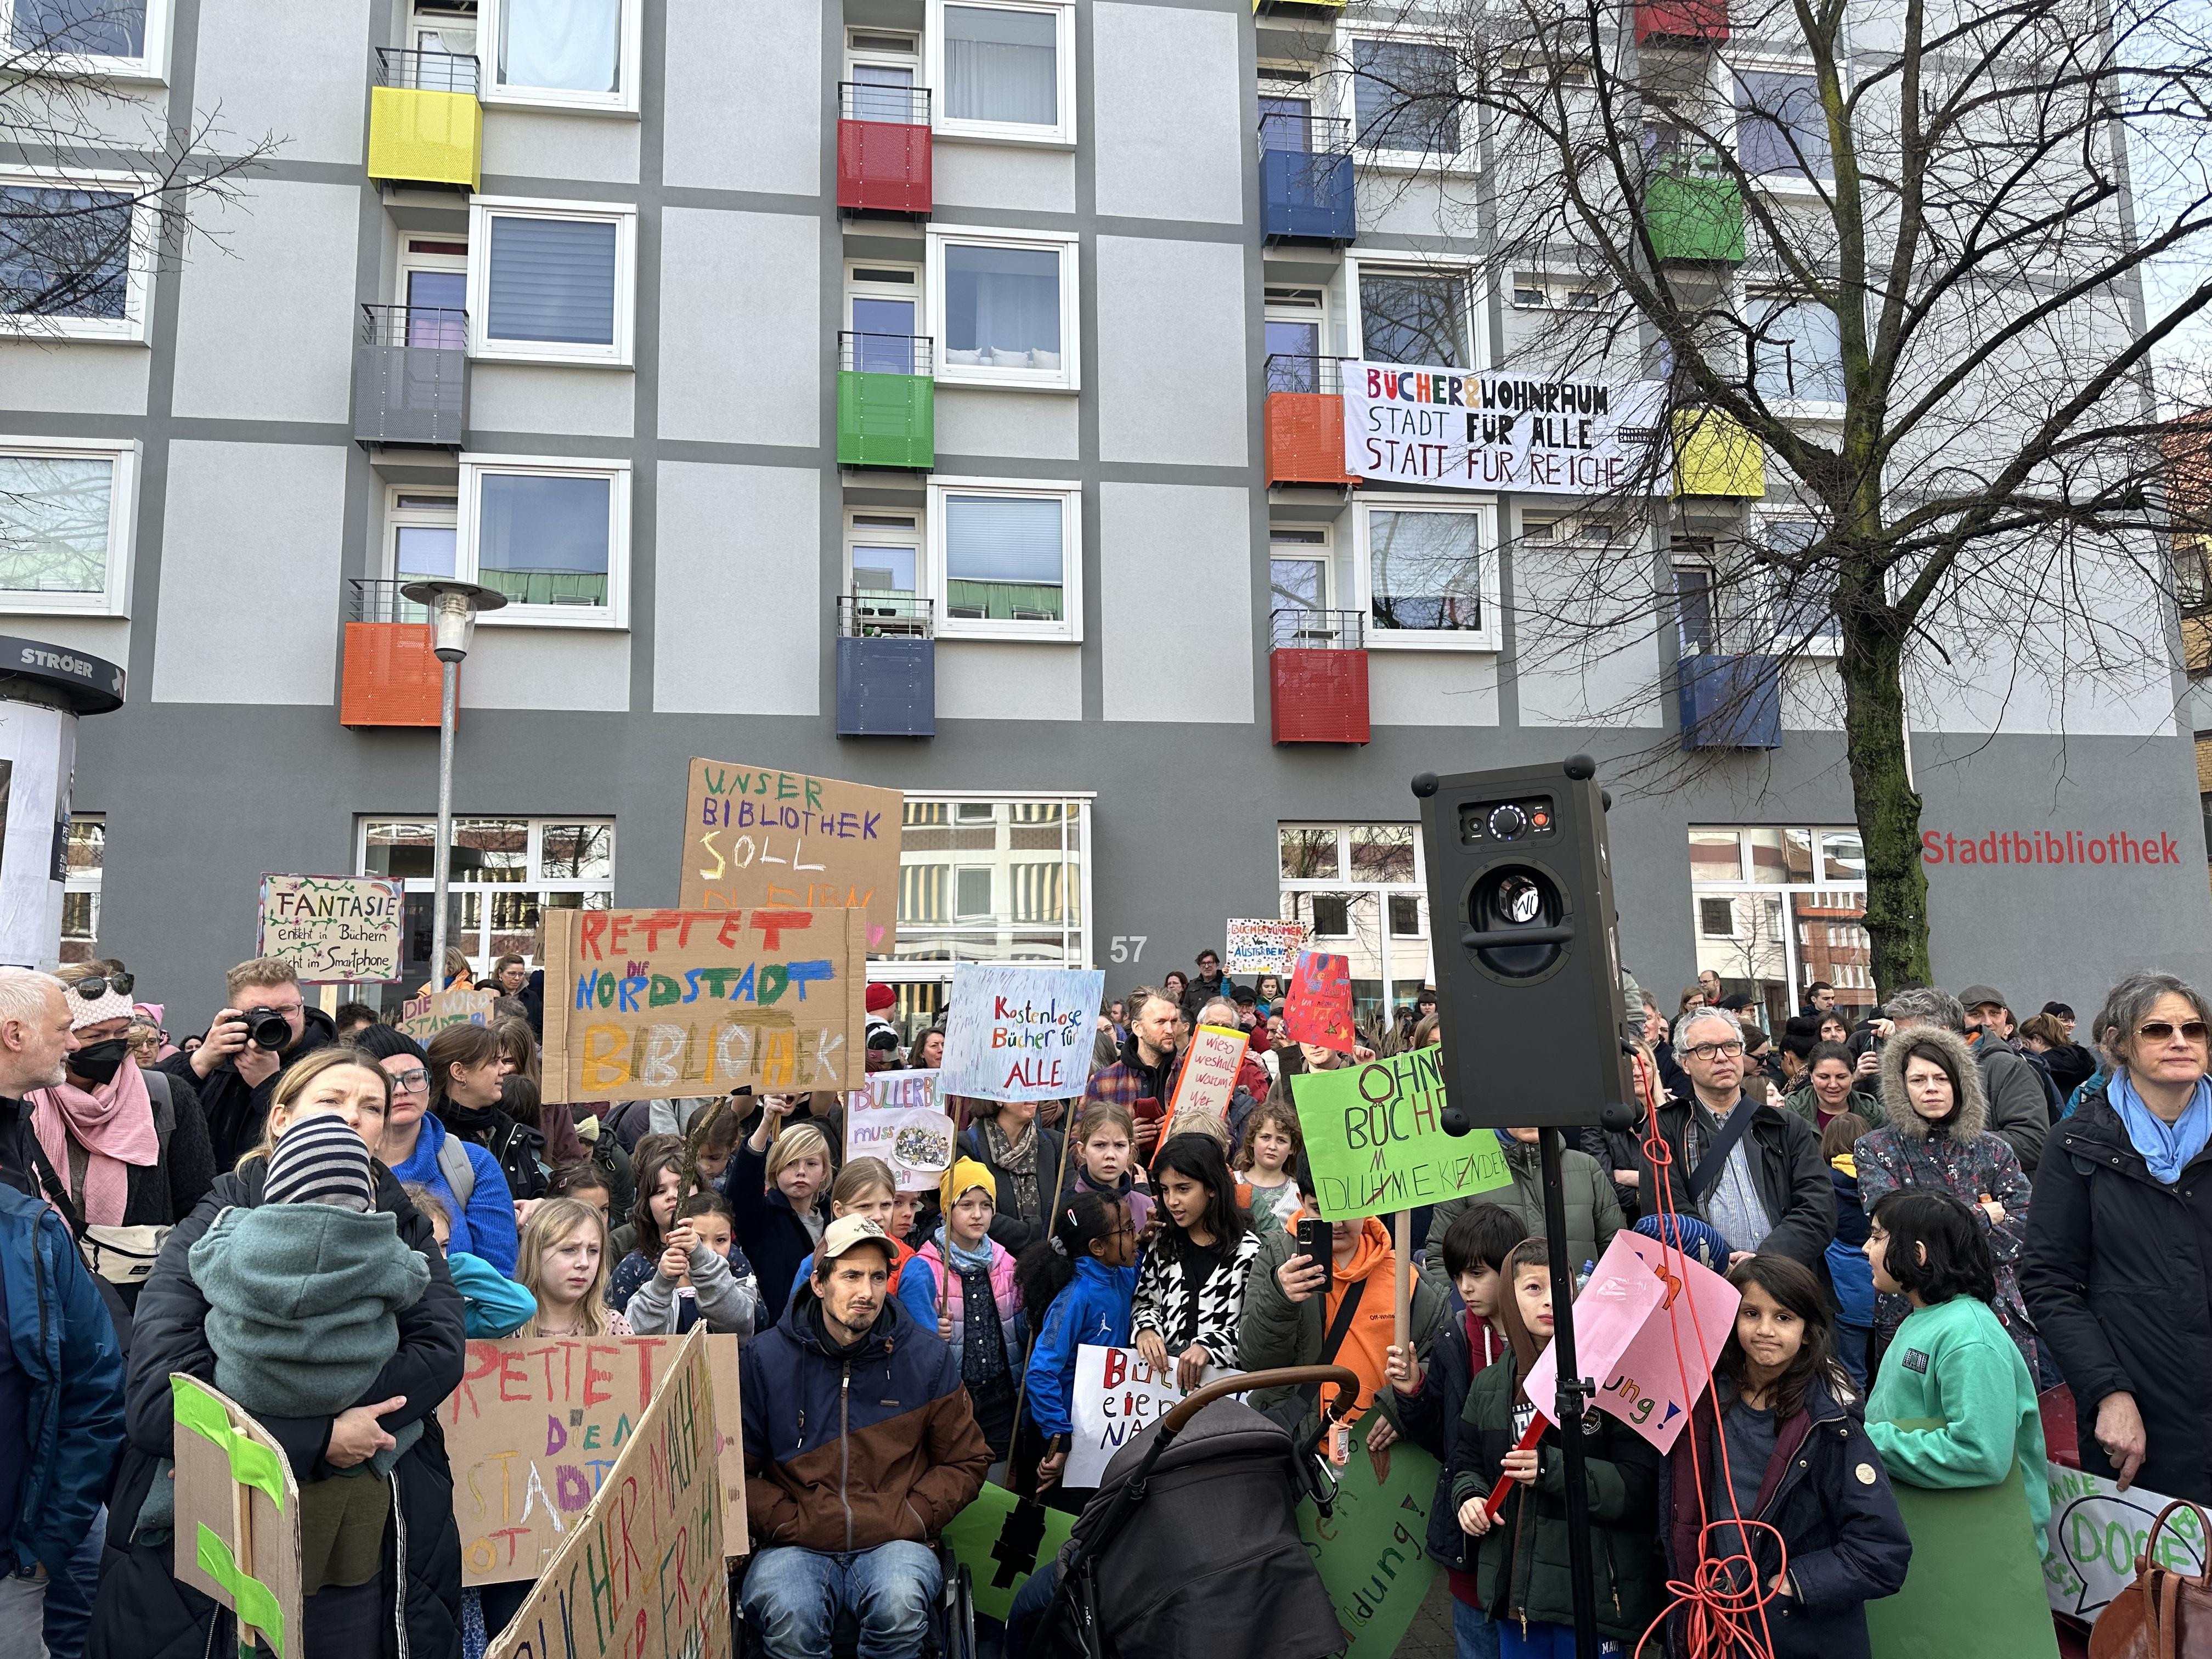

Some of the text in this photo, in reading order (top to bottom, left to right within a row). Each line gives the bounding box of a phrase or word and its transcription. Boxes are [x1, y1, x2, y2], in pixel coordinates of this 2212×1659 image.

[1369, 405, 1592, 450] STADT FÜR ALLE
[1367, 438, 1627, 488] STATT FÜR REICHE
[21, 648, 93, 678] STRÖER
[704, 766, 823, 811] UNSER
[703, 797, 882, 840] BIBLIOTHEK
[699, 831, 827, 881] SOLL
[1922, 831, 2181, 864] Stadtbibliothek
[276, 893, 397, 917] FANTASIE
[319, 930, 328, 939] in
[338, 923, 387, 942] Büchern
[580, 910, 813, 961] RETTET
[1109, 935, 1148, 963] 57
[307, 958, 319, 968] im
[319, 946, 389, 973] Smartphone
[627, 960, 650, 978] DIE
[575, 960, 837, 1013] NORDSTADT
[405, 994, 433, 1020] DIE
[995, 995, 1082, 1028] Kostenlose
[991, 1025, 1079, 1049] Bücher für
[1003, 1057, 1063, 1088] ALLE
[854, 1126, 895, 1144] muss
[452, 1339, 667, 1425] RETTET
[466, 1451, 617, 1534] STADT
